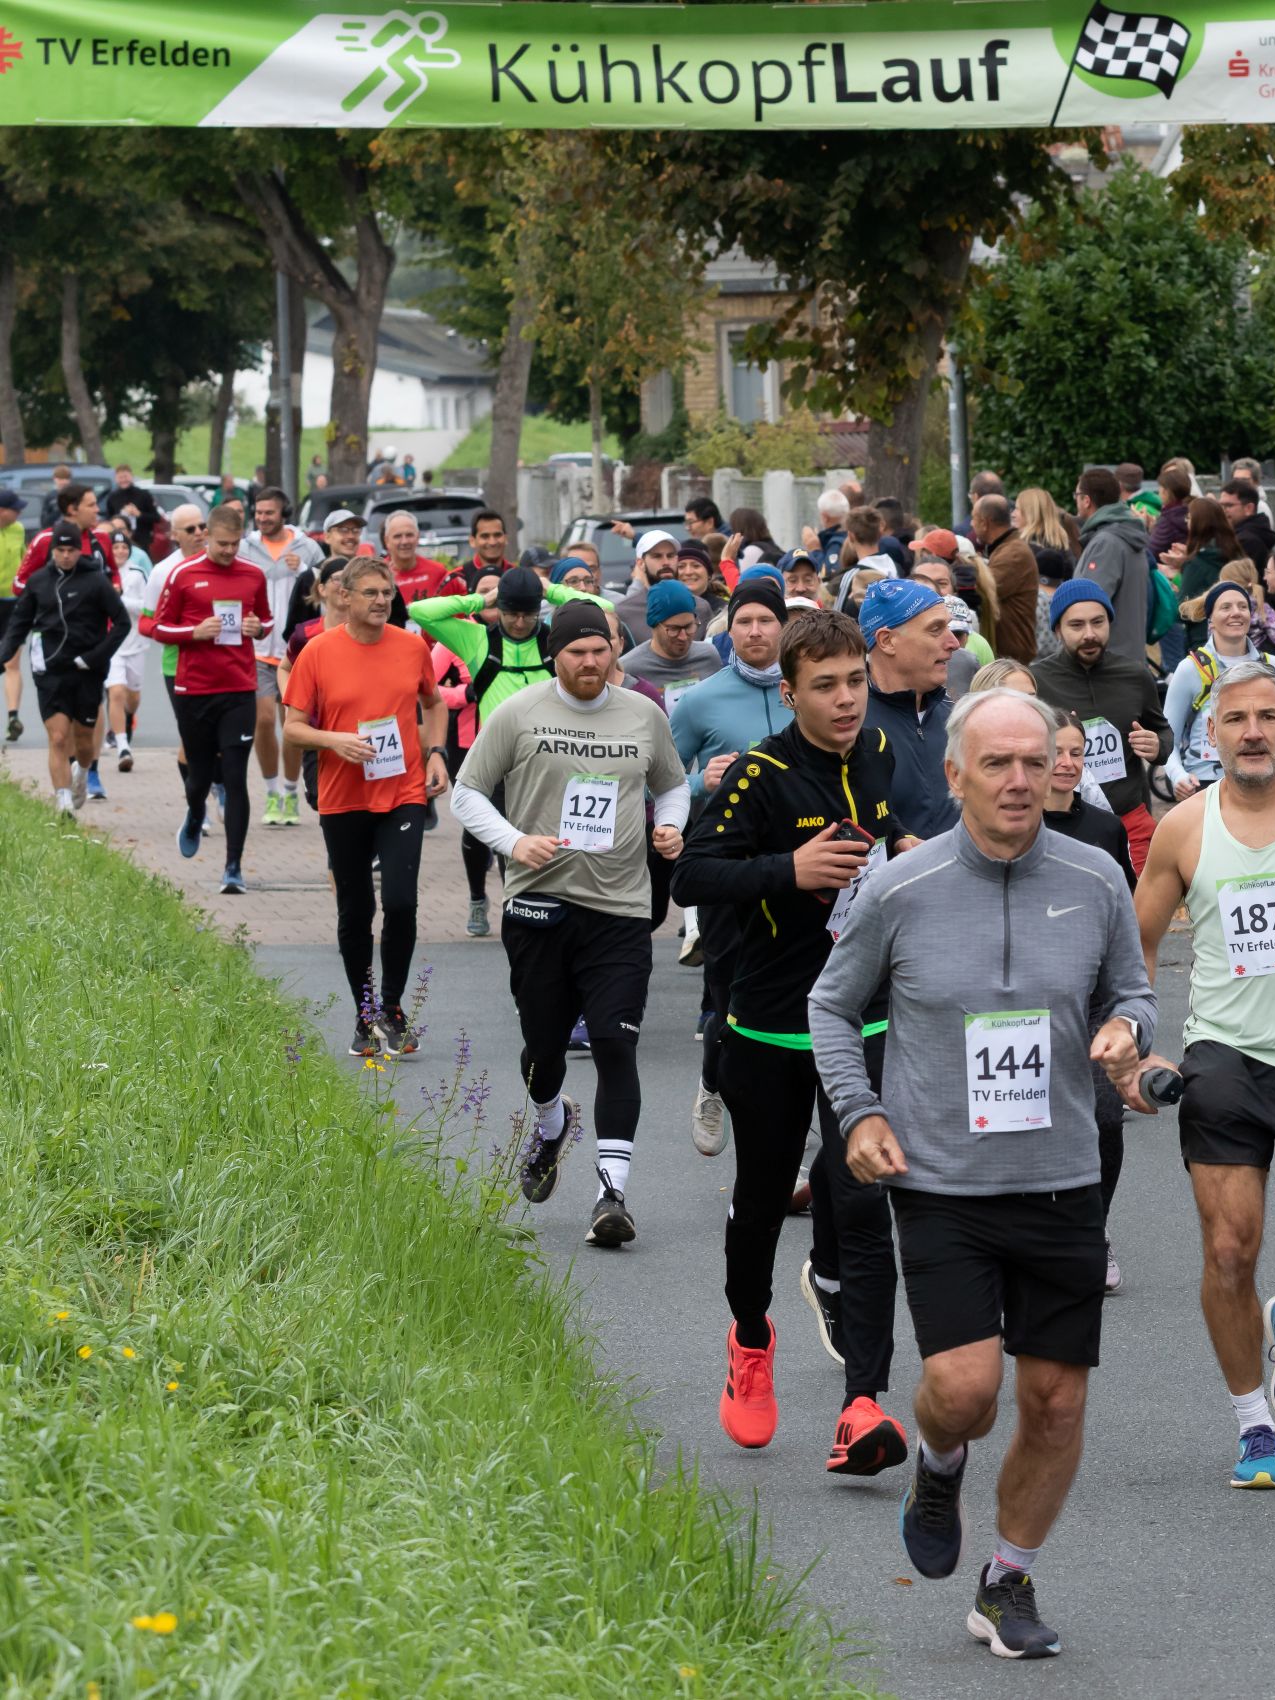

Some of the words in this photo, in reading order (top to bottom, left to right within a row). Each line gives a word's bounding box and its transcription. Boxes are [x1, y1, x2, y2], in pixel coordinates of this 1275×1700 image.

[36, 38, 81, 65] TV
[91, 39, 231, 68] Erfelden
[488, 40, 1009, 121] KühkopfLauf
[548, 727, 596, 739] UNDER
[536, 740, 639, 759] ARMOUR
[1085, 733, 1117, 757] 220
[1094, 756, 1122, 768] Erfelden
[569, 794, 612, 819] 127
[875, 800, 890, 820] JK
[563, 821, 576, 830] TV
[576, 822, 612, 834] Erfelden
[796, 816, 825, 828] JAKO
[1229, 943, 1245, 954] TV
[991, 1017, 1041, 1028] KühkopfLauf
[975, 1043, 1045, 1080] 144
[972, 1090, 990, 1102] TV
[994, 1088, 1046, 1101] Erfelden
